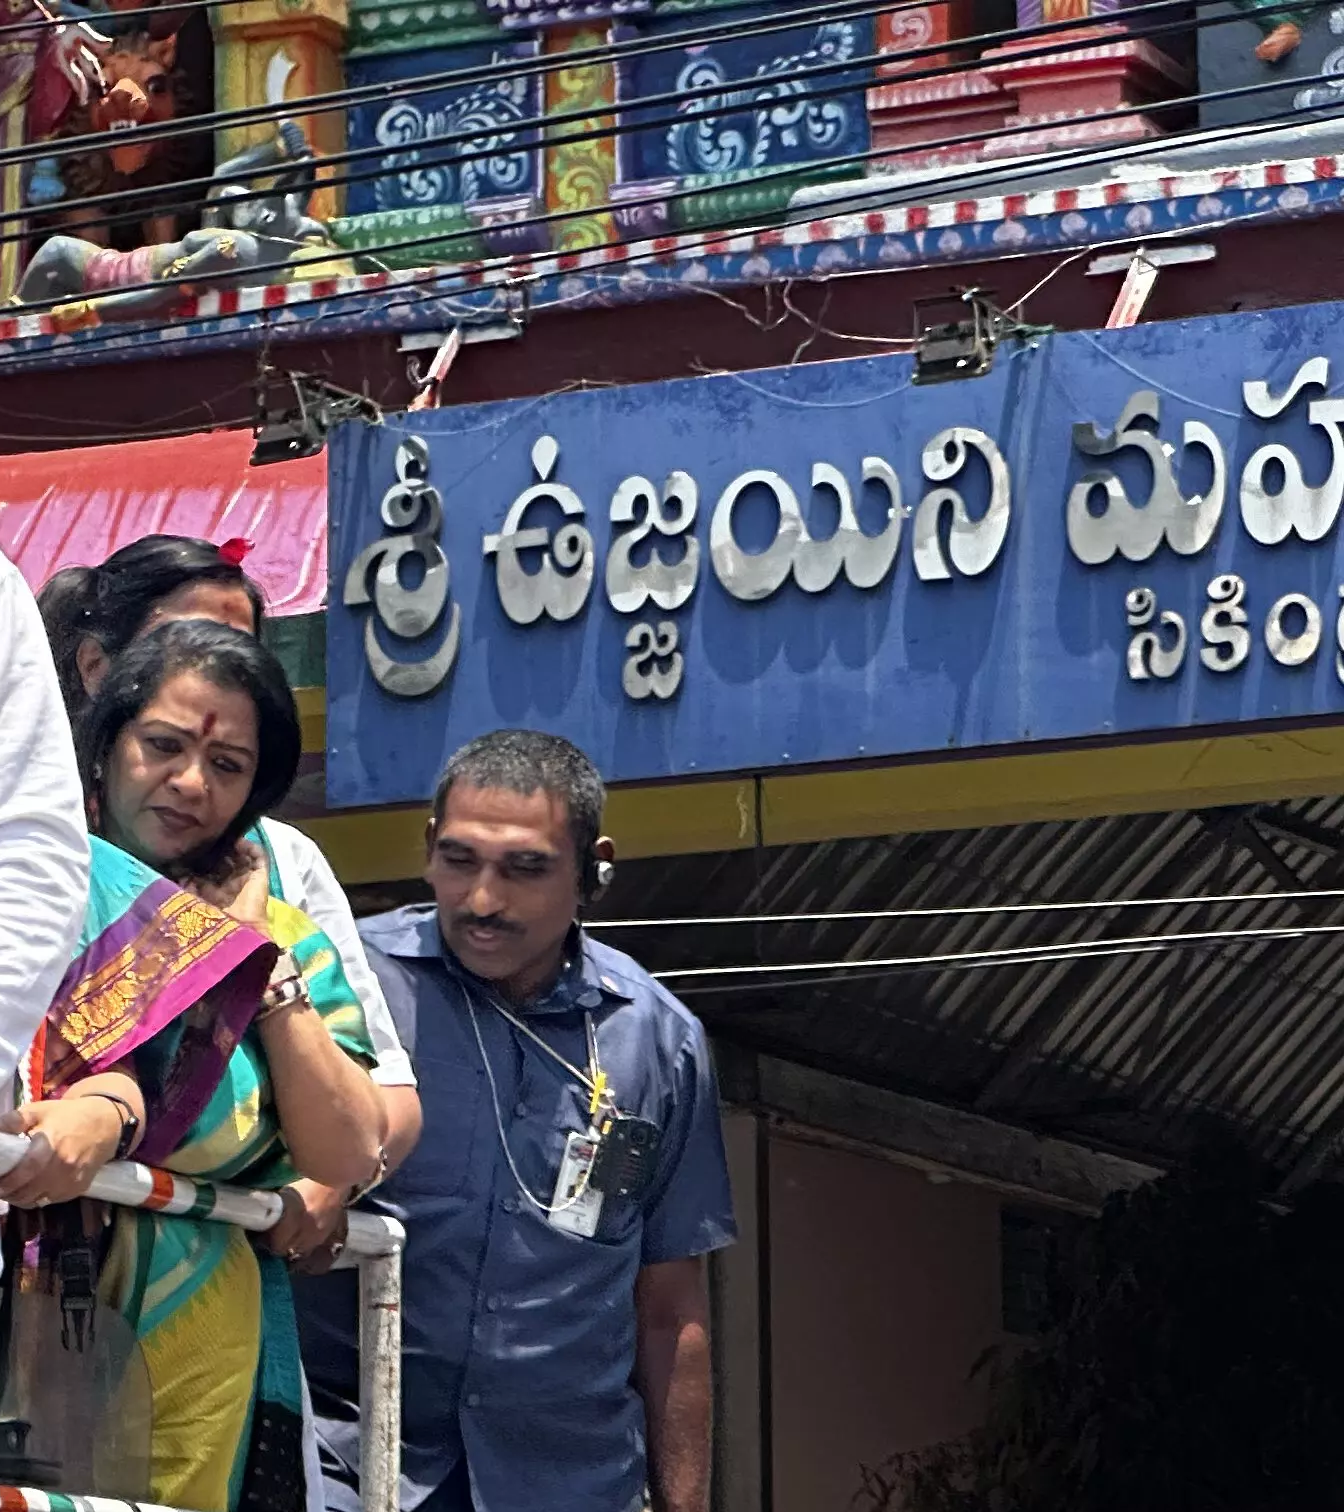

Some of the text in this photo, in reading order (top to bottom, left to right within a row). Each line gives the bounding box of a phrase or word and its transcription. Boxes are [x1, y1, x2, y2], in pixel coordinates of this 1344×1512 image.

[344, 434, 461, 697] శ్రీ
[483, 425, 1012, 701] ఉజ్జయిని
[1125, 574, 1344, 679] సికిం
